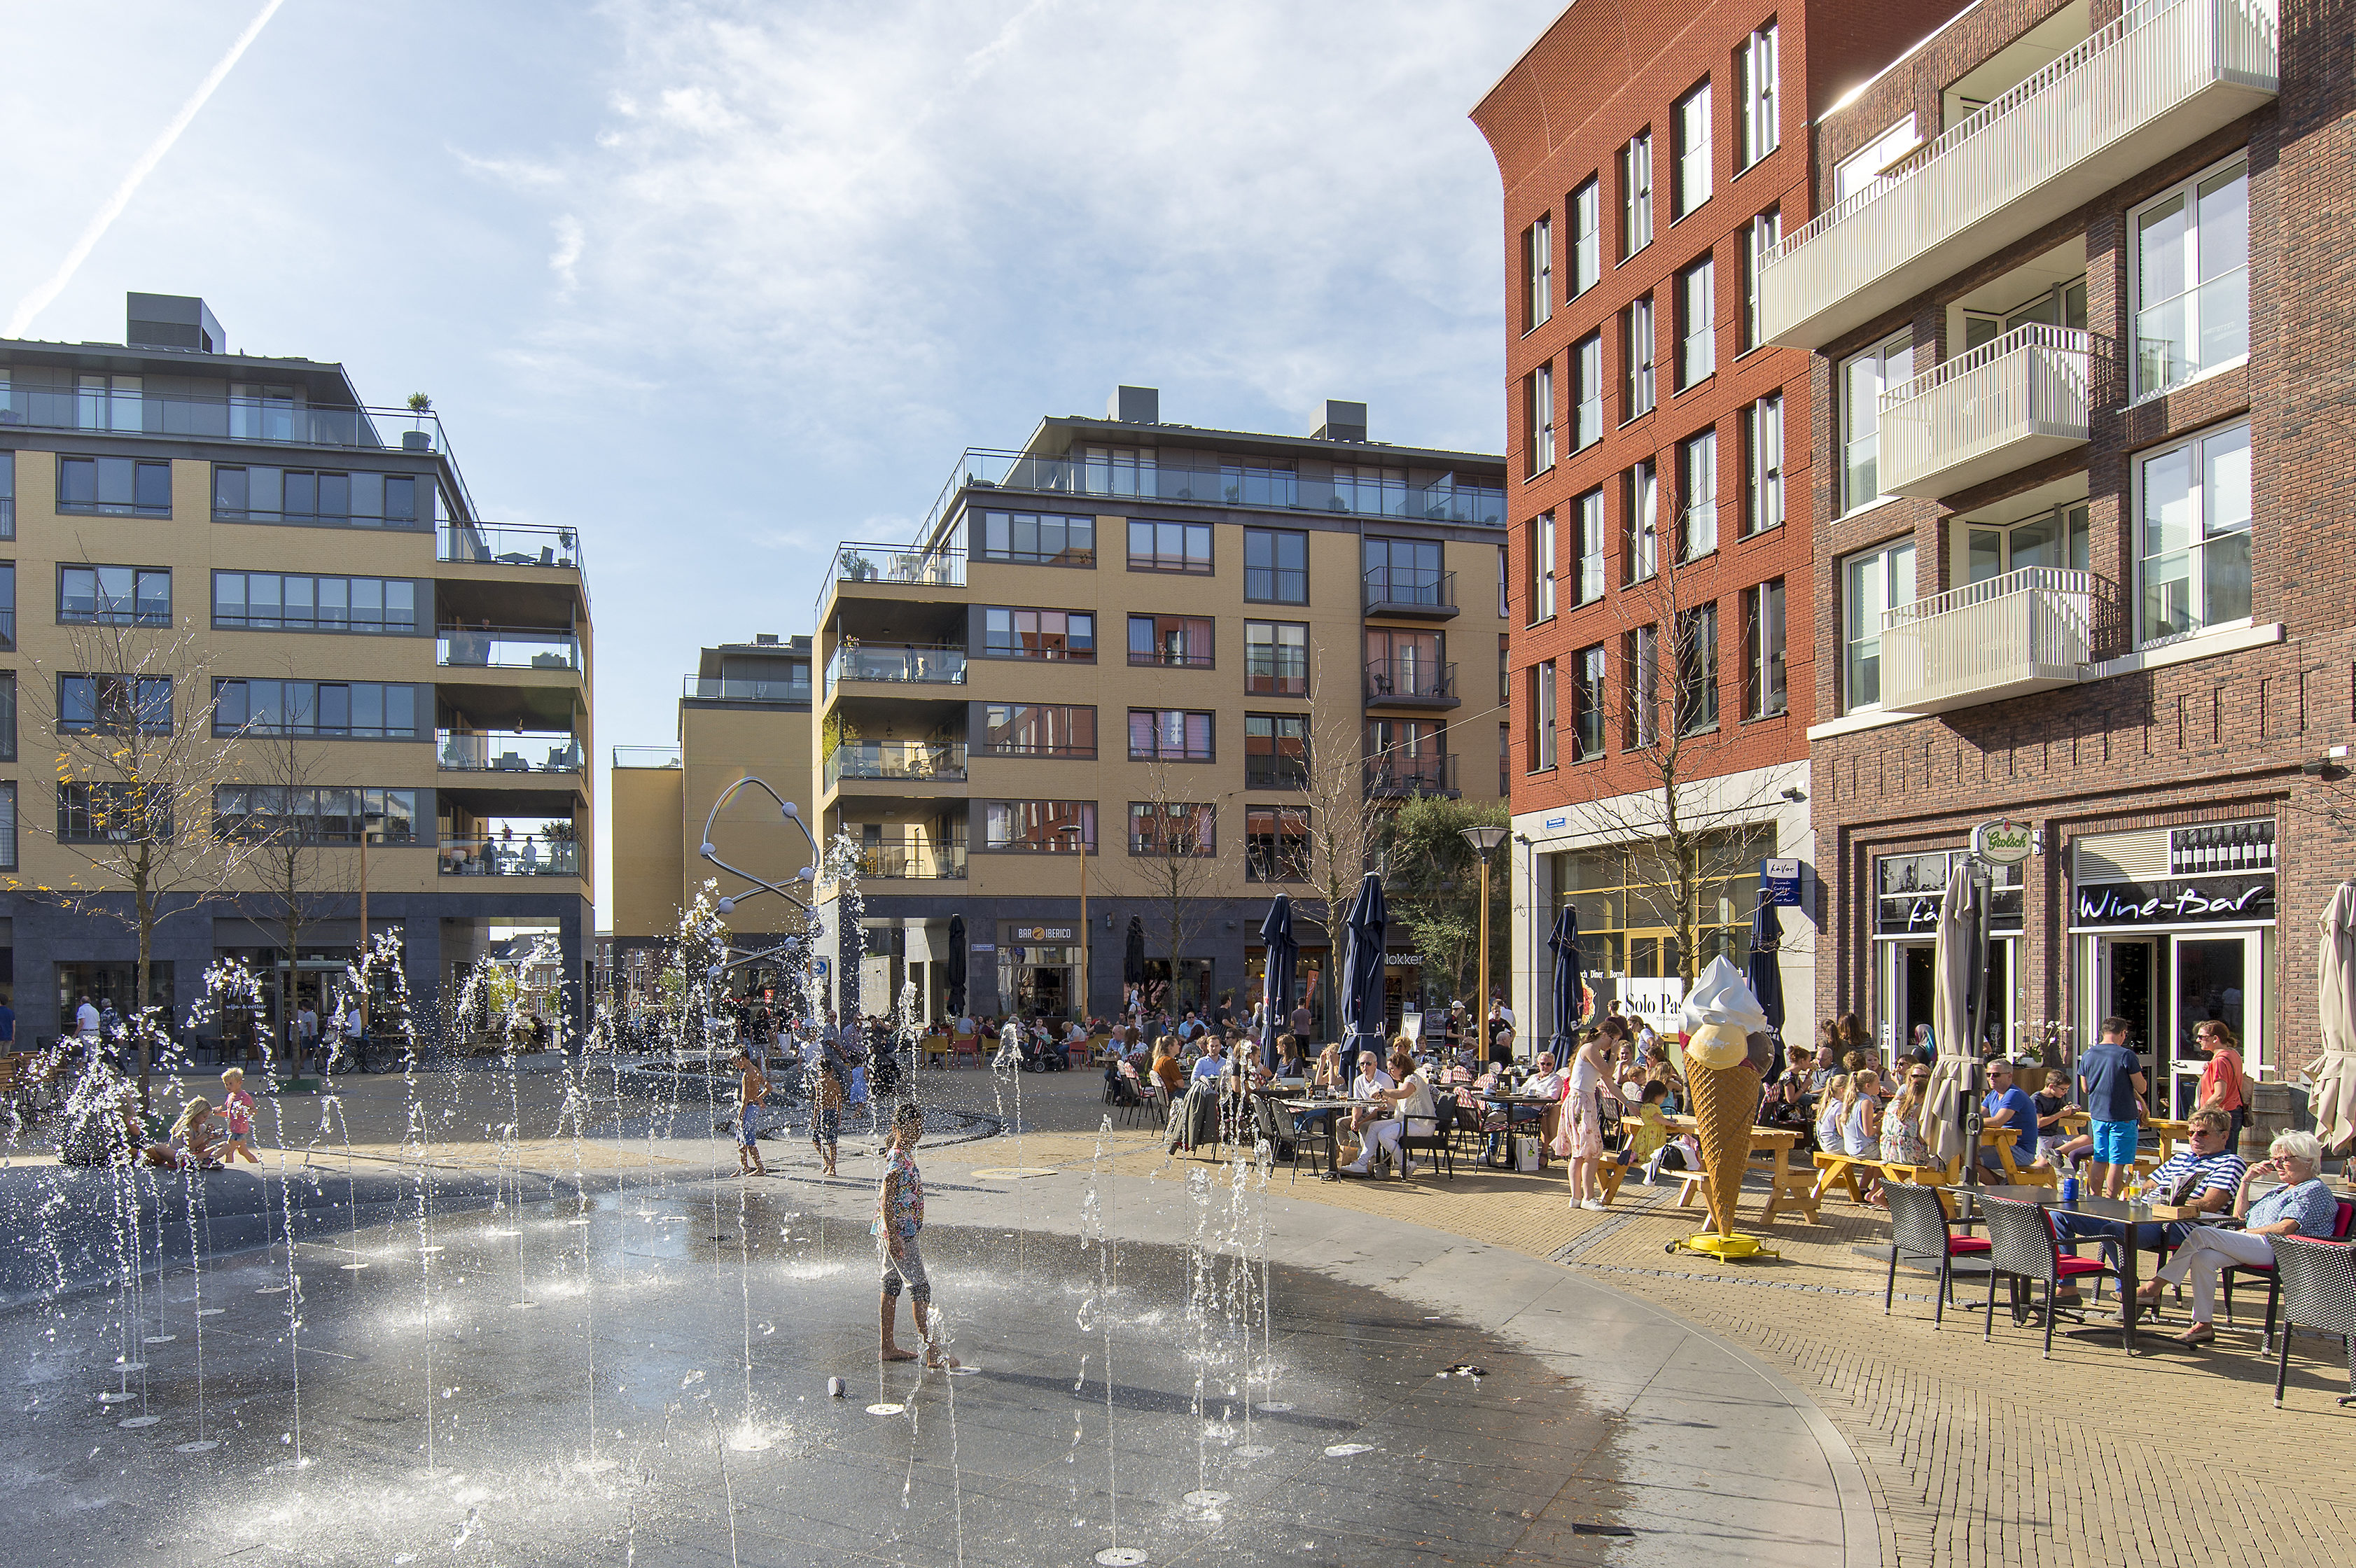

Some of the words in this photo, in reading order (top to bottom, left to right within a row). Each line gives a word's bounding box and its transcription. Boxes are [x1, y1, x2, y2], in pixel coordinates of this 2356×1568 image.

[1987, 831, 2028, 850] Grolsch
[2080, 886, 2265, 919] Wine-Bar
[1018, 928, 1032, 938] BAR
[1045, 928, 1071, 938] IBERICO
[1385, 953, 1424, 965] lokker
[1590, 969, 1604, 979] Diner
[1610, 969, 1625, 979] Borrel
[1626, 993, 1656, 1014] Solo
[1661, 993, 1682, 1014] Pas
